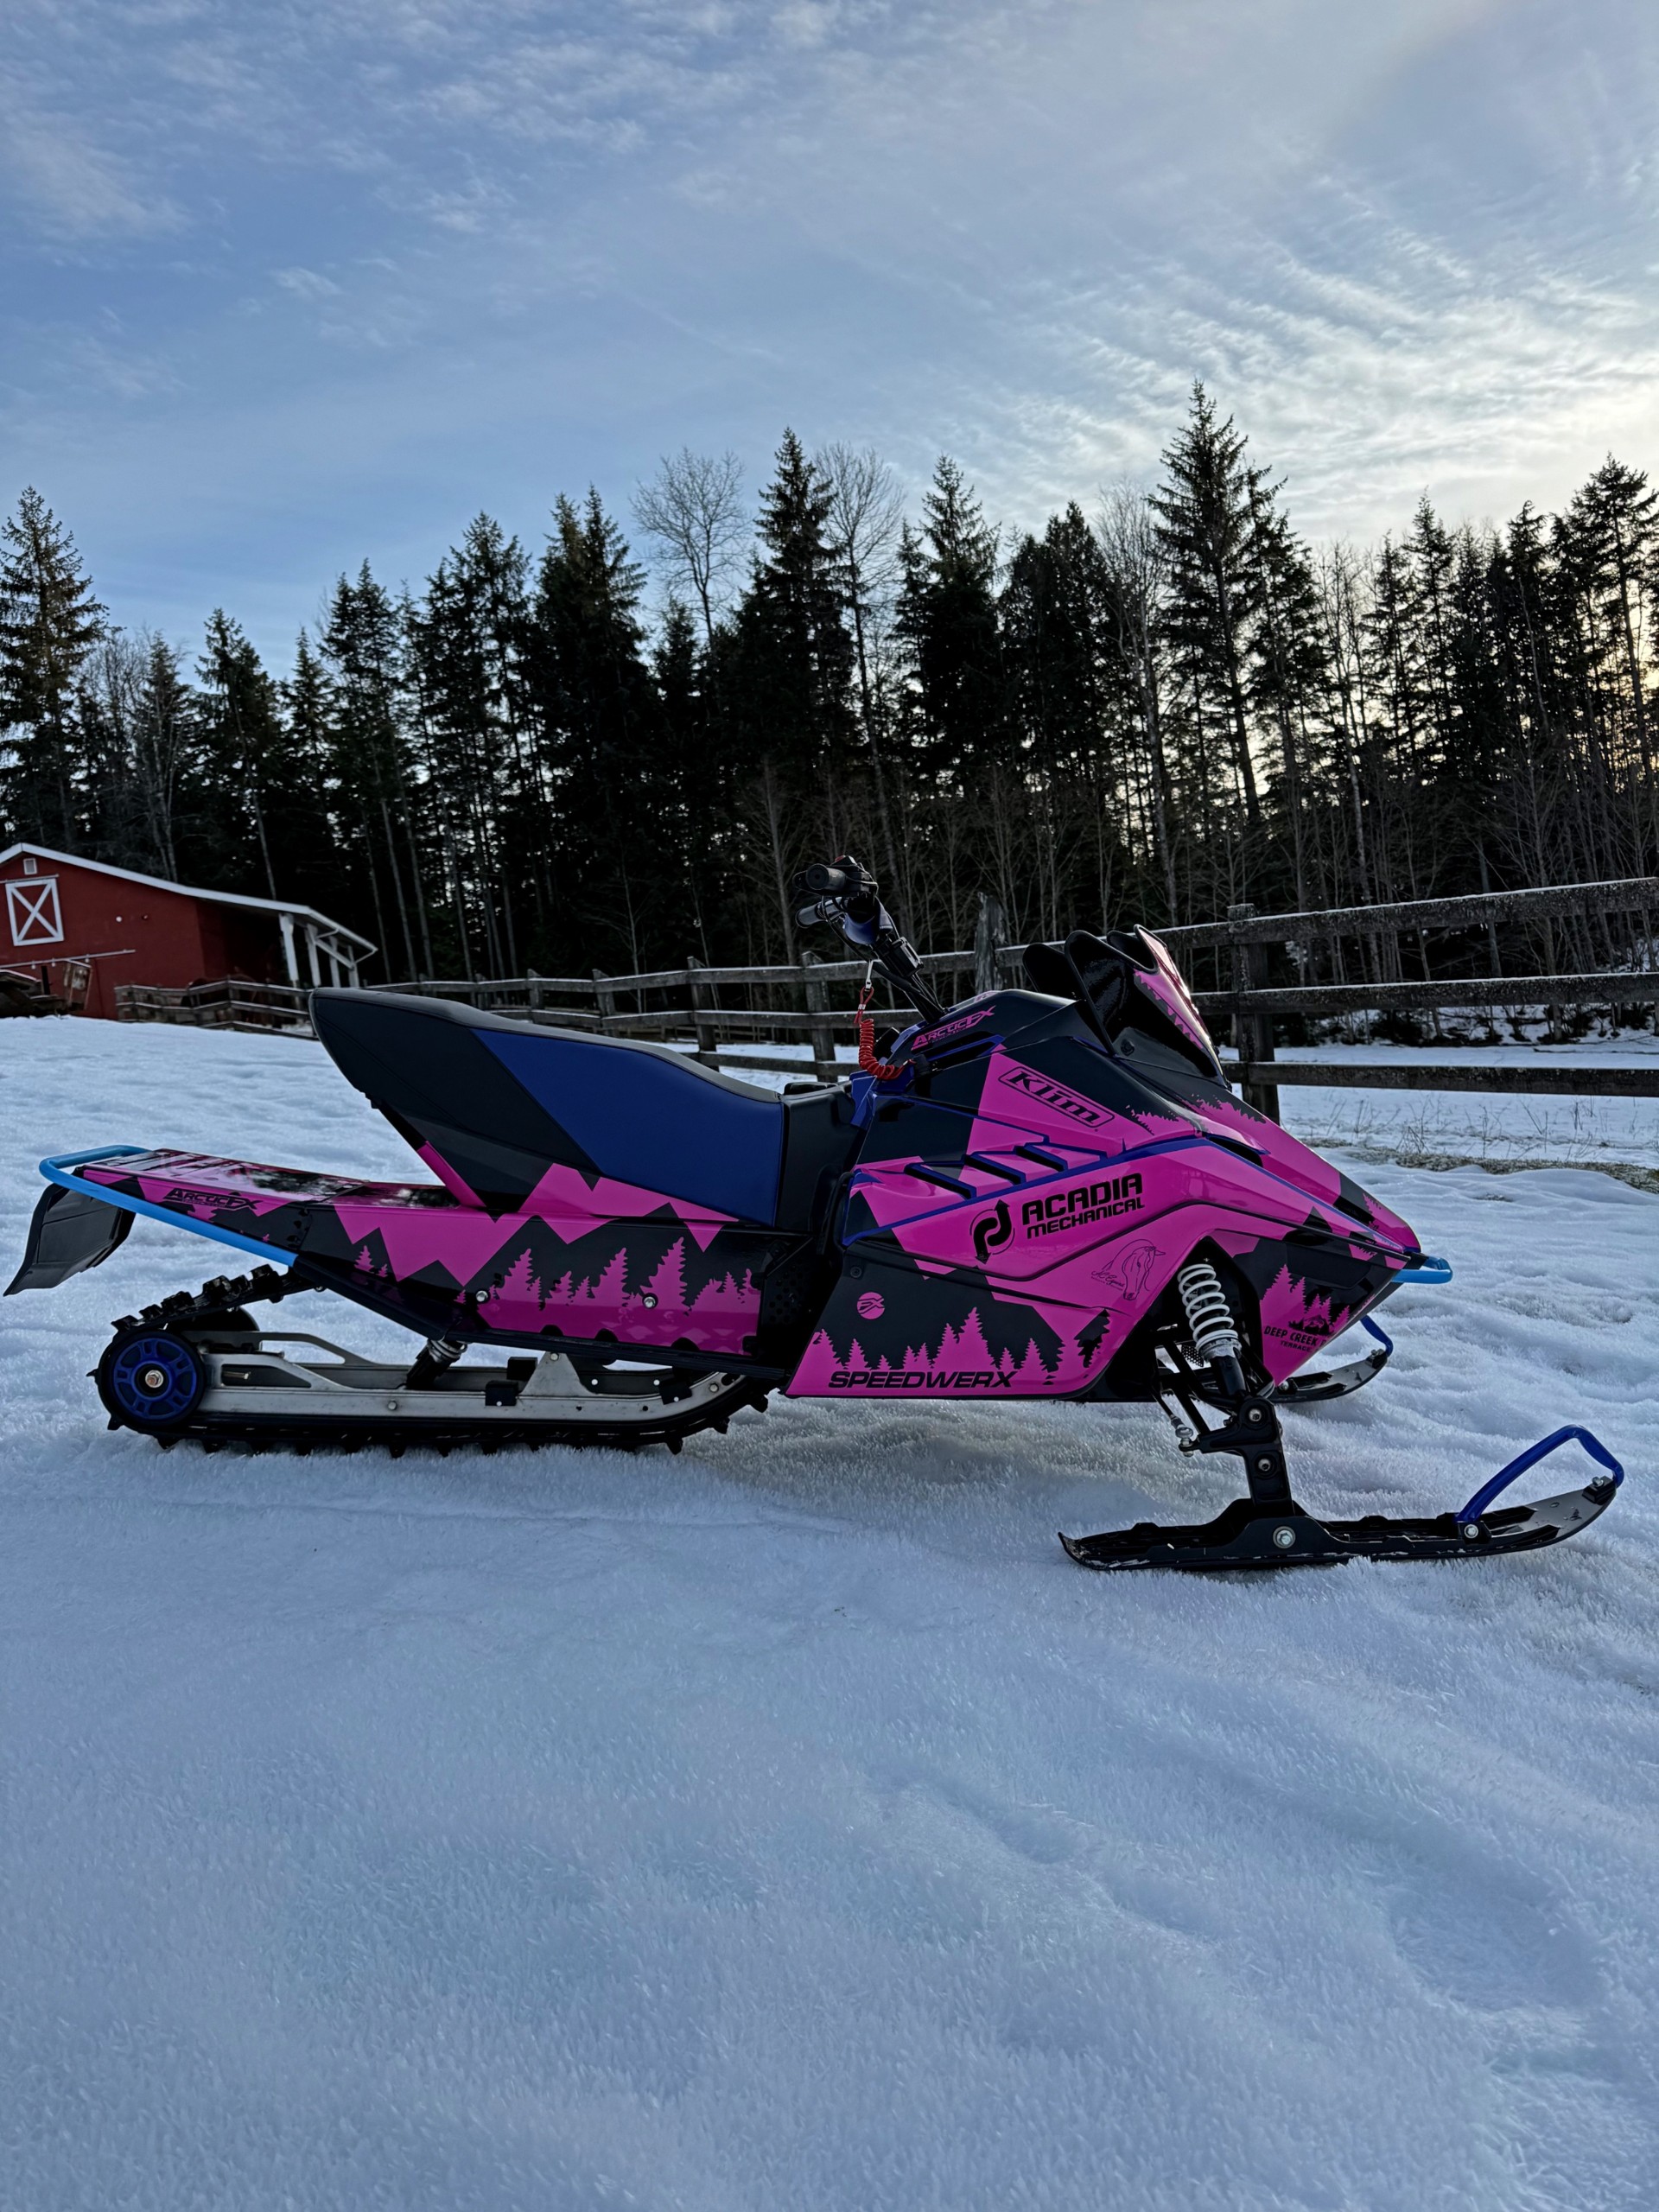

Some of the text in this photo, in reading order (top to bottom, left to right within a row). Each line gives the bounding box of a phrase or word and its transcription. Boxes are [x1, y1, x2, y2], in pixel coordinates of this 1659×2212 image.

[1022, 1173, 1143, 1225] ACADIA
[1027, 1197, 1145, 1239] MECHANICAL
[1264, 1325, 1287, 1338] DEEP
[1289, 1332, 1319, 1346] CREEK
[828, 1370, 1019, 1389] SPEEDWERX
